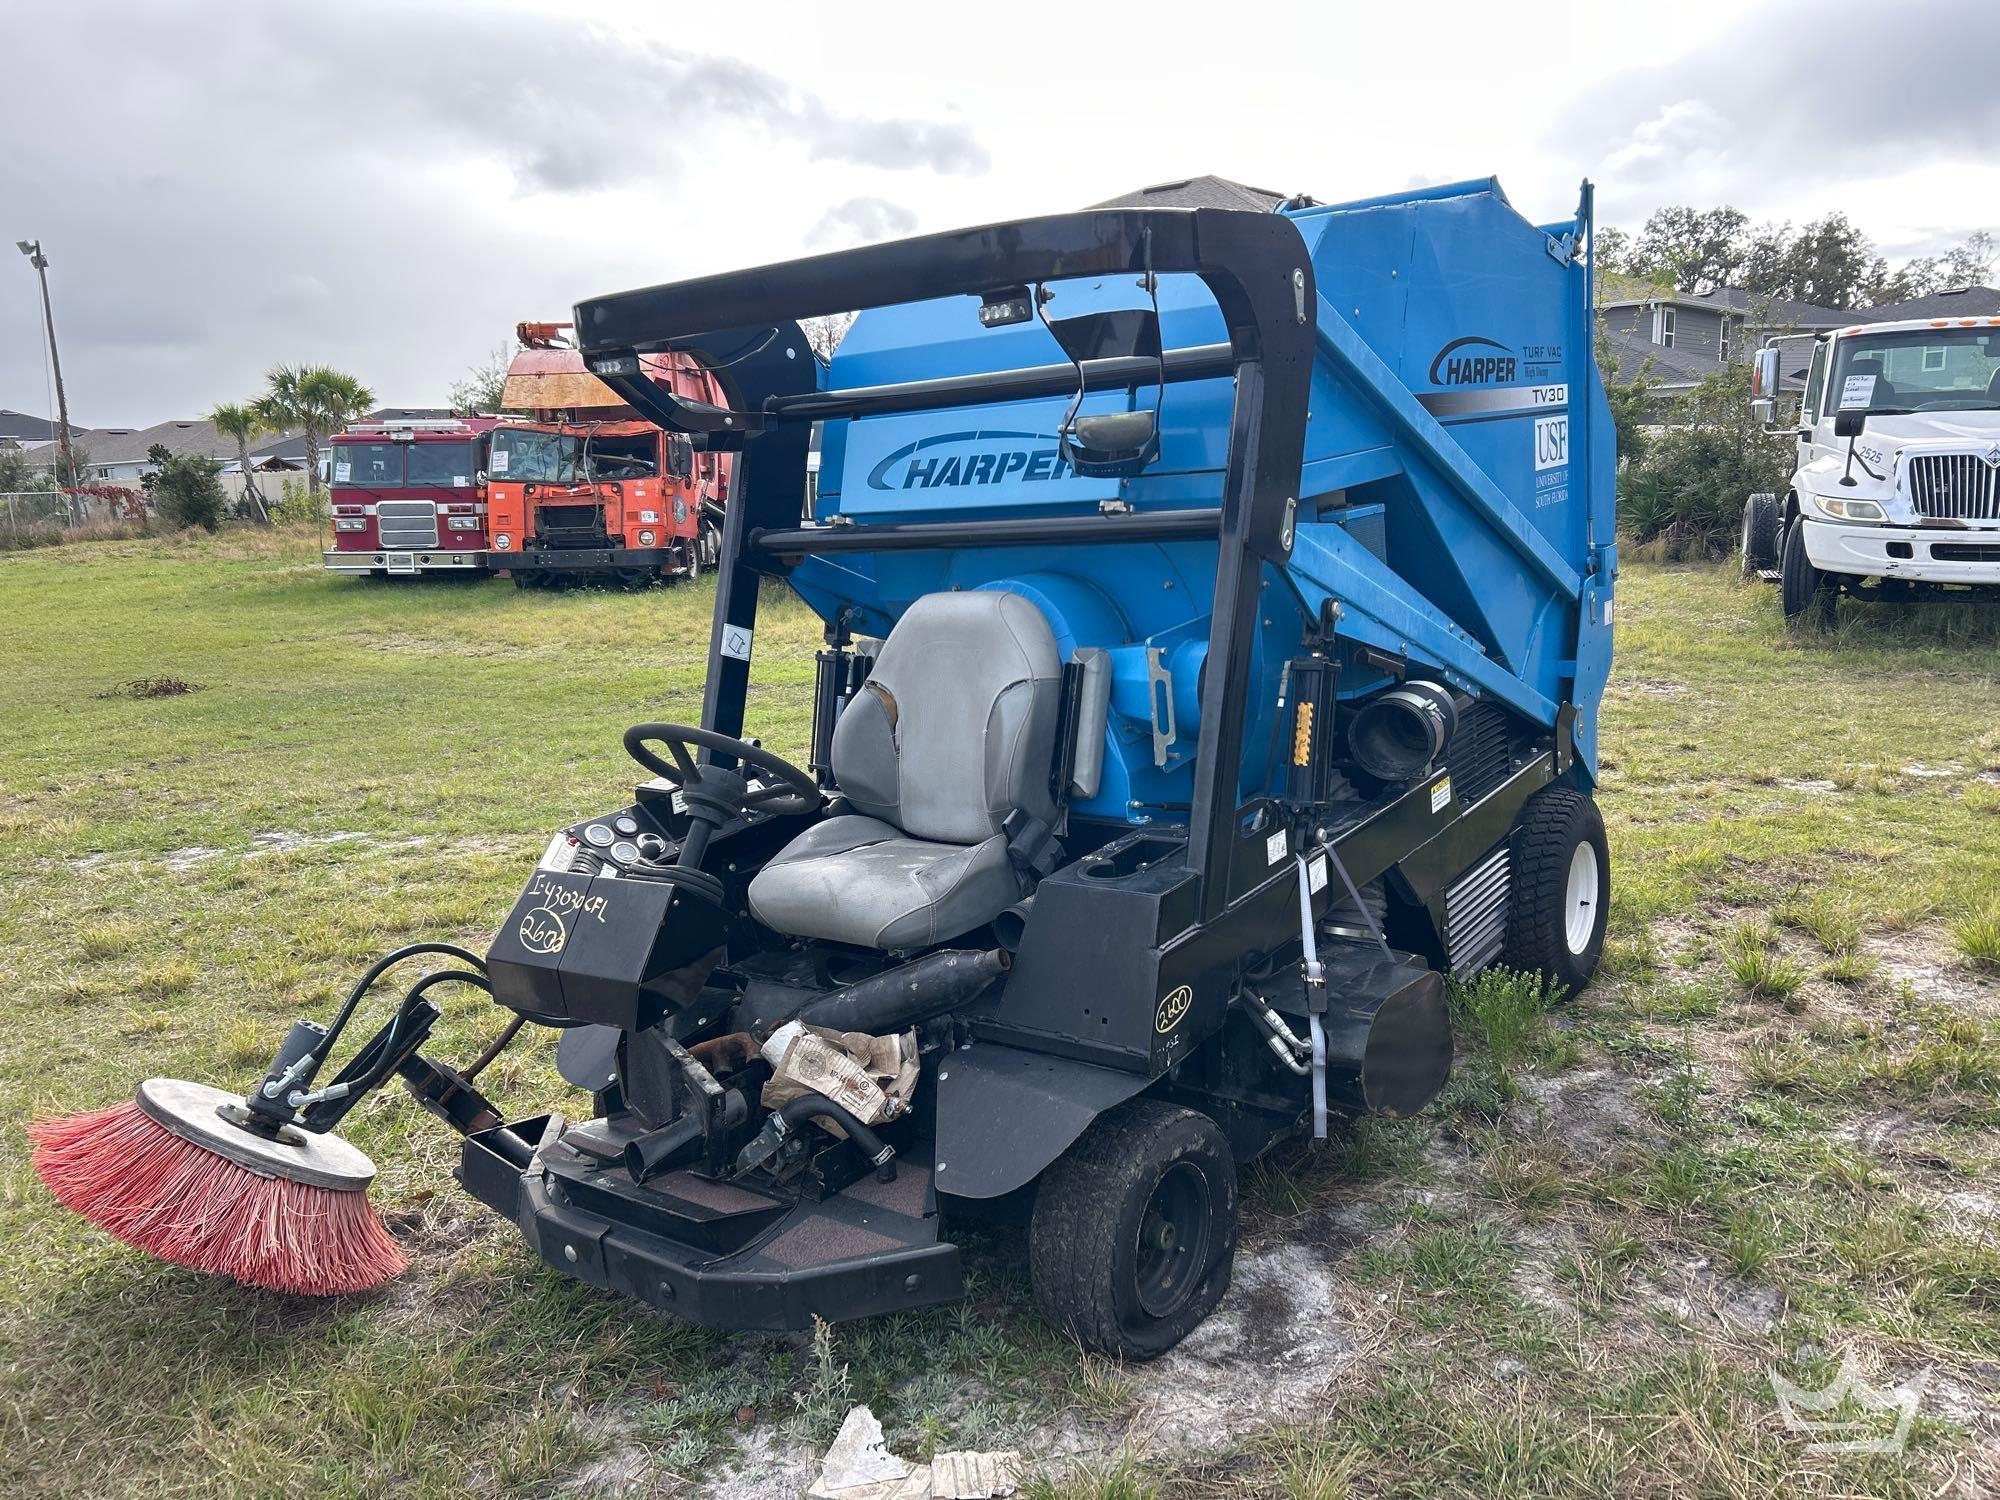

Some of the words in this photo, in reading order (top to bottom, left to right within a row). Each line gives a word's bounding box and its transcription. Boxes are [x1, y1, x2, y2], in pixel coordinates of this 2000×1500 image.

[1523, 346, 1545, 358] TURF
[1547, 346, 1562, 358] VAC
[1446, 357, 1516, 385] HARPER
[1532, 387, 1564, 403] TV30
[1537, 420, 1566, 464] USF
[1860, 446, 1883, 464] 2525
[1536, 471, 1562, 488] UNIVERSITY
[1536, 494, 1551, 509] SOUTH
[1552, 489, 1569, 504] FLORIDA
[1159, 989, 1187, 1029] 2600
